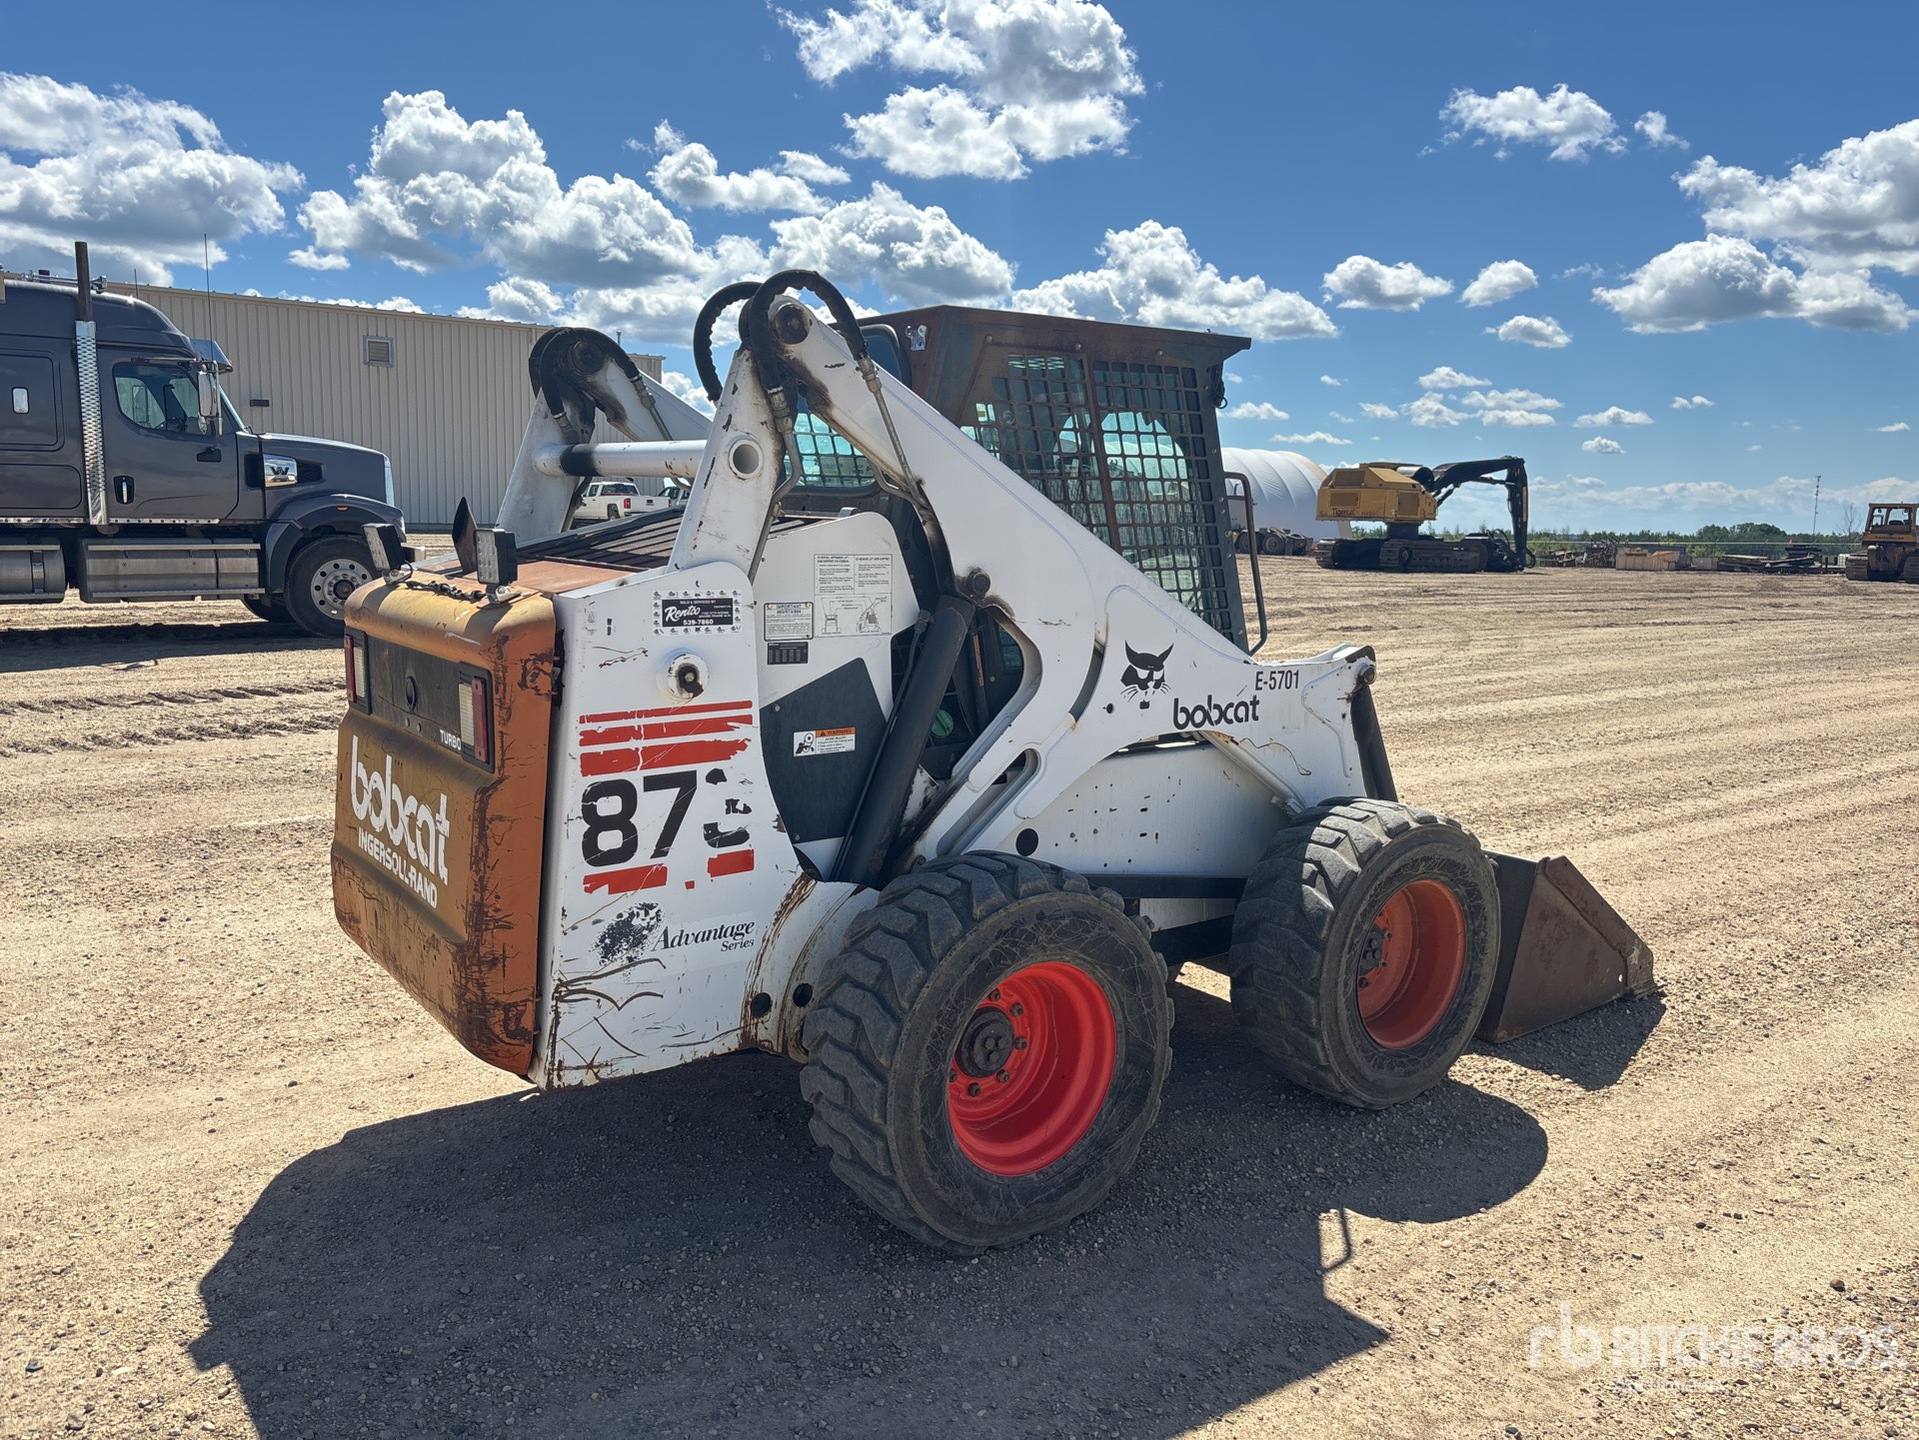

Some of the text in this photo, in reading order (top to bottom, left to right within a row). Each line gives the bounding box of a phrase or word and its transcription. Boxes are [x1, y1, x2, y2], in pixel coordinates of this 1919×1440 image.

[1254, 669, 1300, 692] E-5701
[1172, 694, 1260, 730] bobcat
[439, 729, 462, 751] TURBO
[351, 734, 450, 886] bobcat
[358, 826, 438, 909] INGERSOLL-RAND
[651, 921, 755, 951] Advantage
[720, 937, 755, 952] Series
